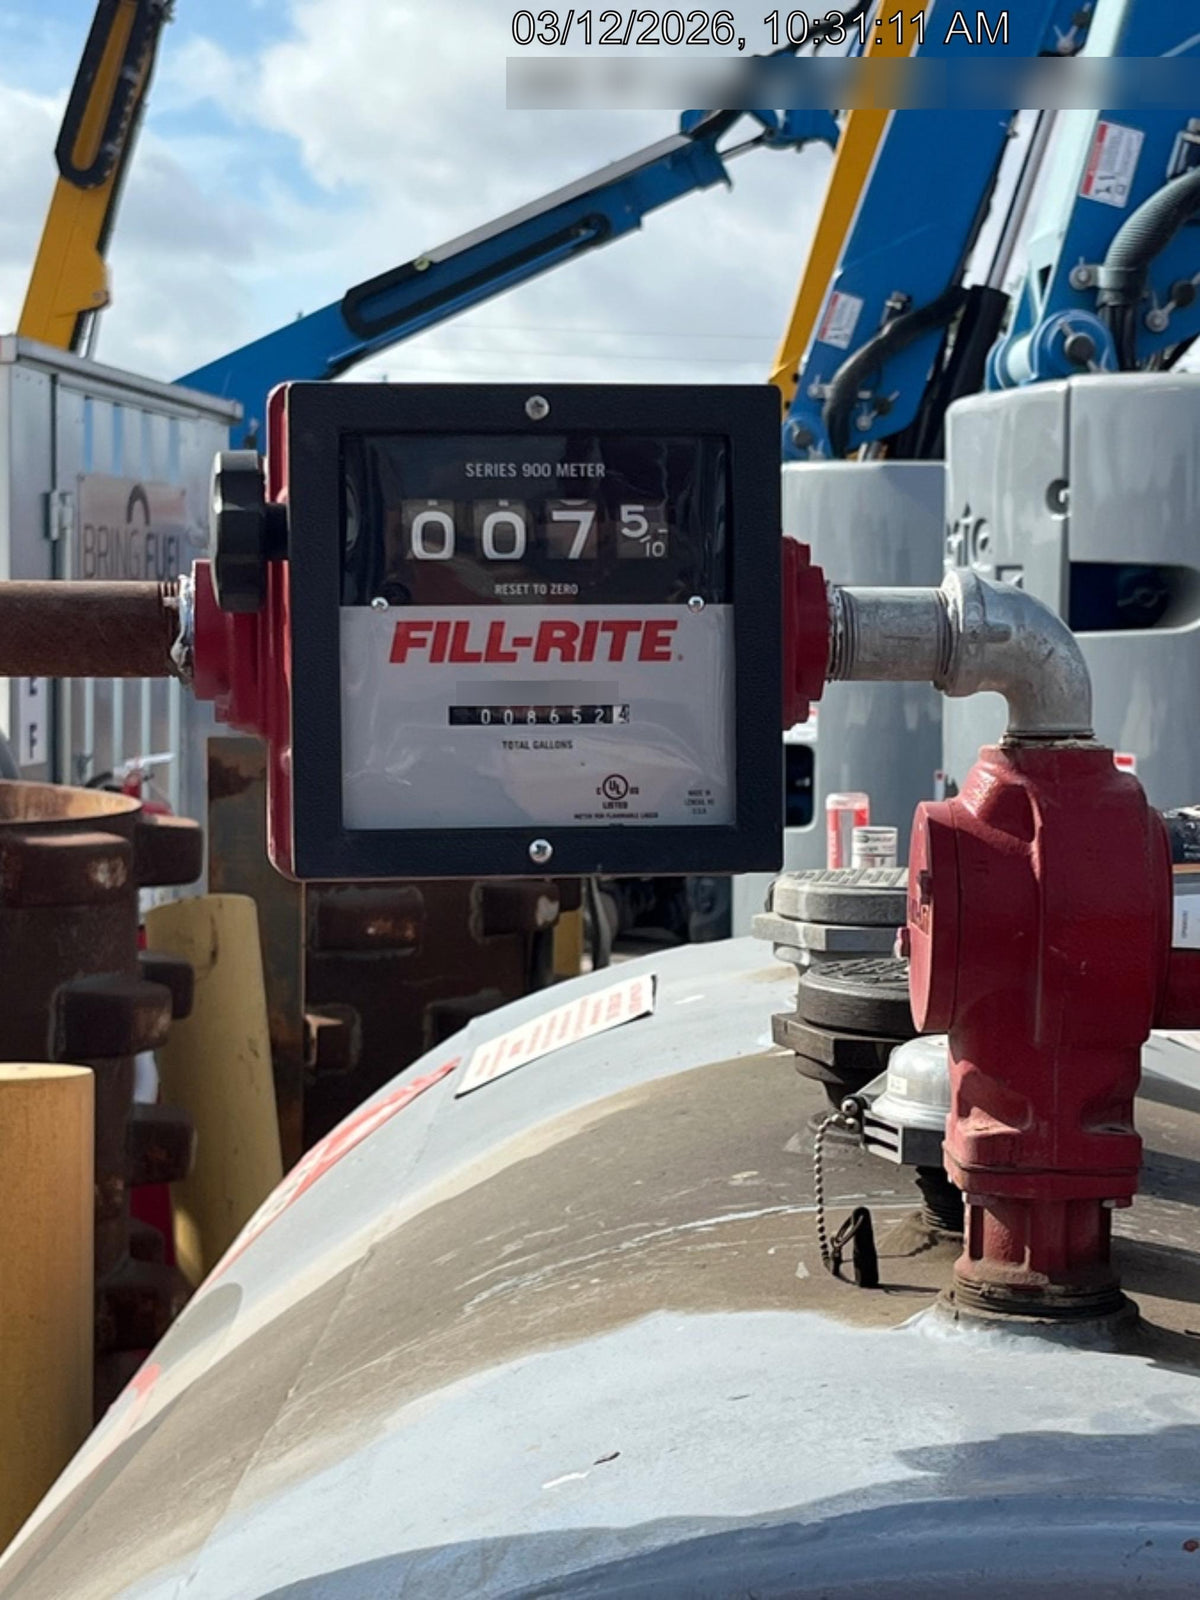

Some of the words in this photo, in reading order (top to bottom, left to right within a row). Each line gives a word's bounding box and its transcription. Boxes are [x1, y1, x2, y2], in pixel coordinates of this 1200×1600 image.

[465, 462, 517, 478] SERIES
[522, 462, 551, 478] 900
[555, 462, 606, 478] METER
[494, 583, 530, 595] RESET
[532, 583, 548, 595] TO
[549, 582, 579, 595] ZERO
[389, 619, 678, 664] FILL-RITE
[502, 740, 530, 750] TOTAL
[533, 740, 574, 750] GALLONS
